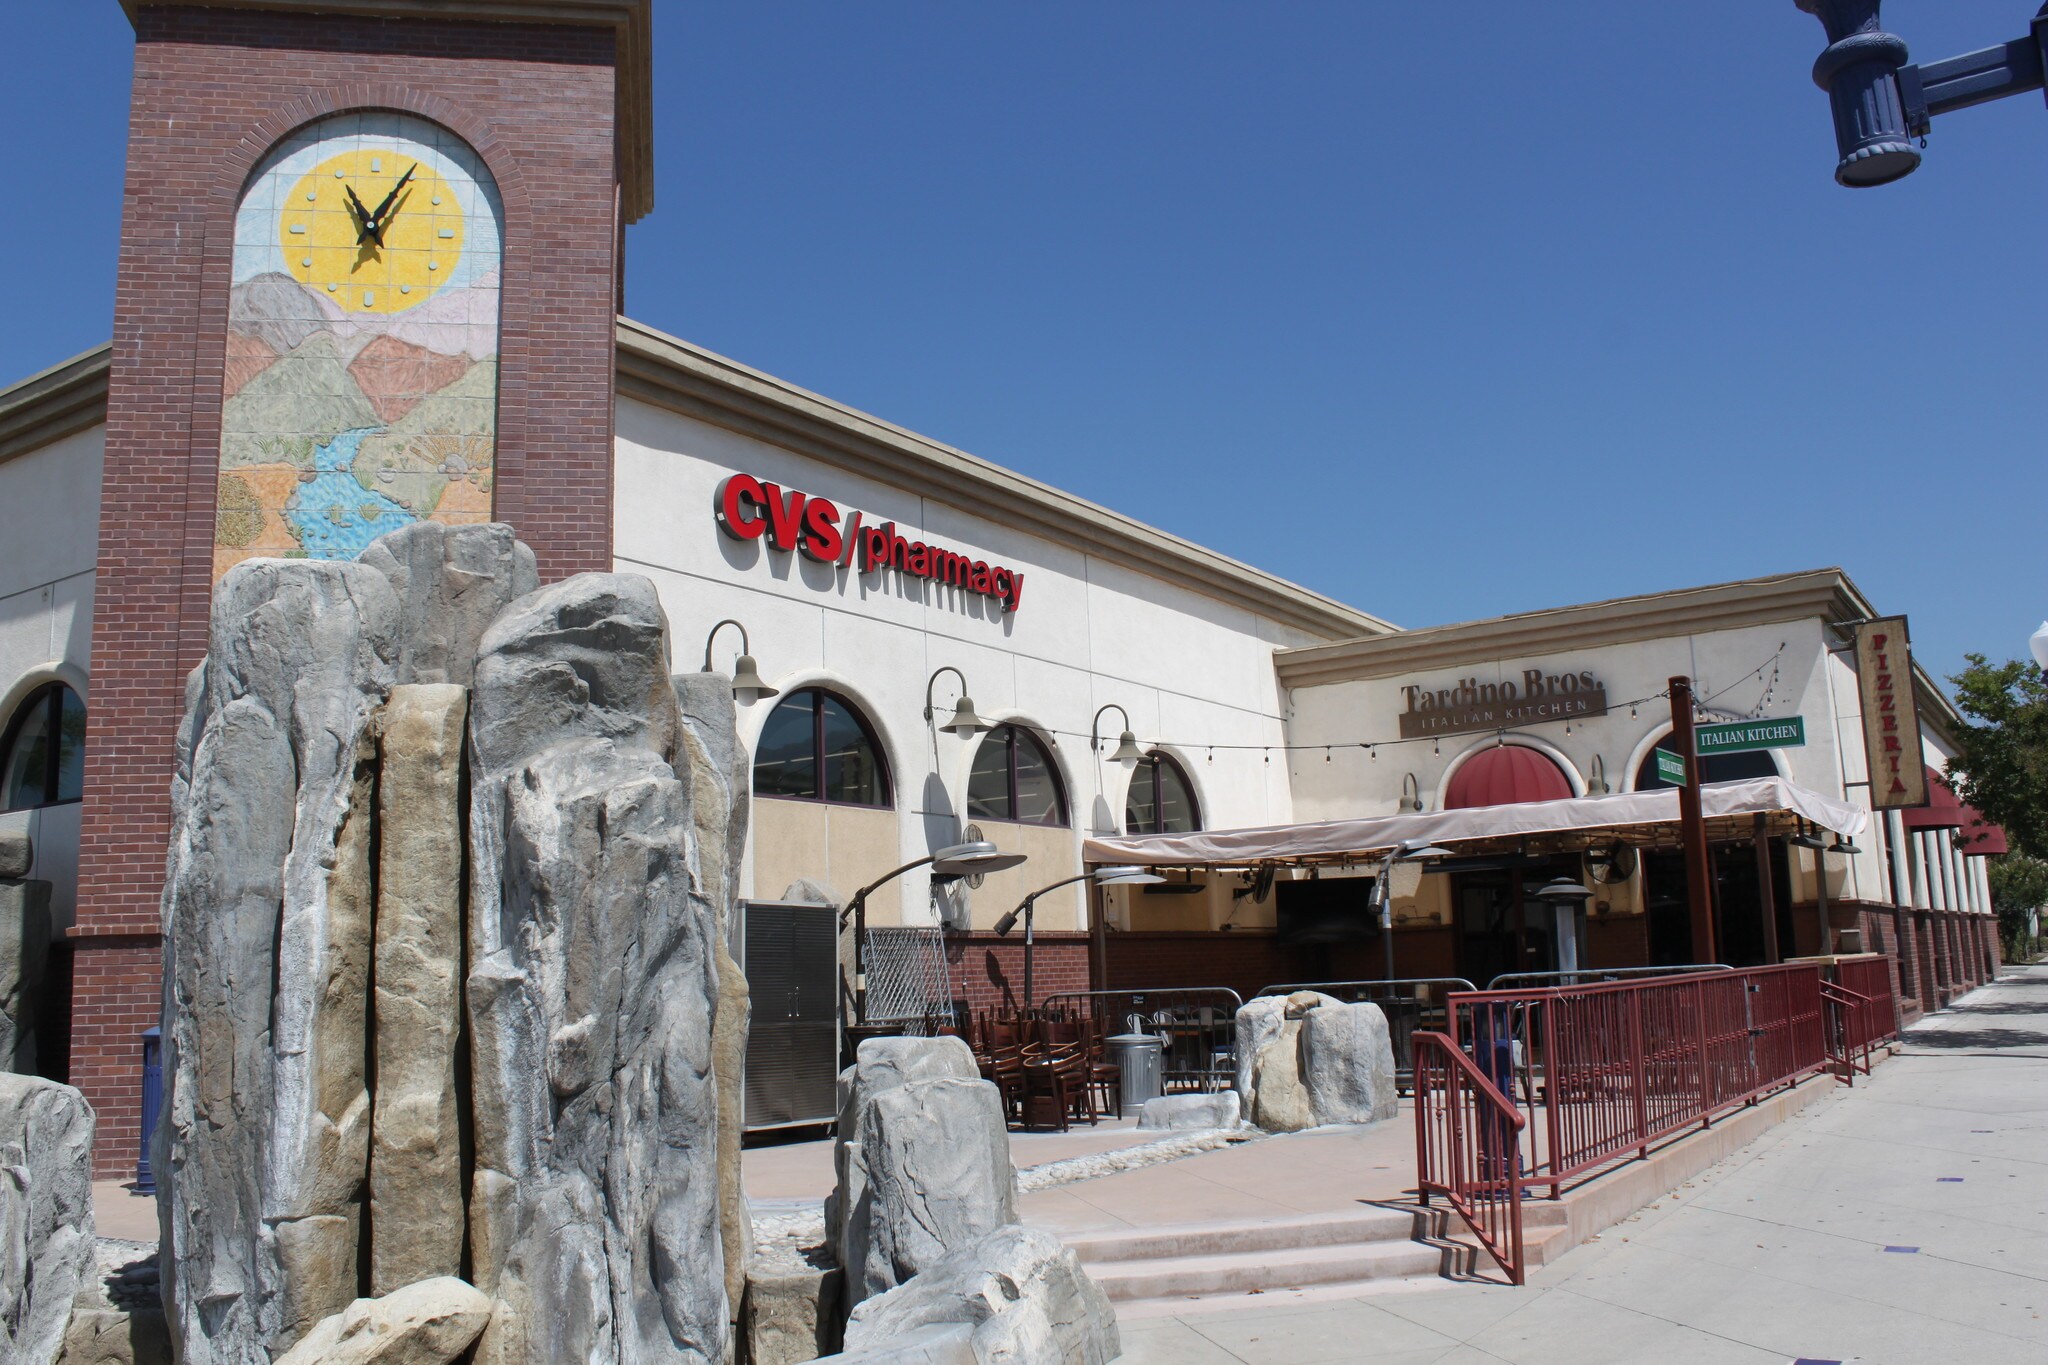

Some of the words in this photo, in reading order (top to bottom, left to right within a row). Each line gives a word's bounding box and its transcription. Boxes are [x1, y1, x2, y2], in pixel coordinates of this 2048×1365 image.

[1401, 677, 1516, 713] Tardino
[1522, 669, 1603, 698] Bros.
[1422, 711, 1493, 729] ITALIAN
[1506, 701, 1586, 718] KITCHEN
[1872, 634, 1906, 793] PIZZERIA
[1701, 730, 1744, 746] ITALIAN
[1748, 725, 1797, 741] KITCHEN
